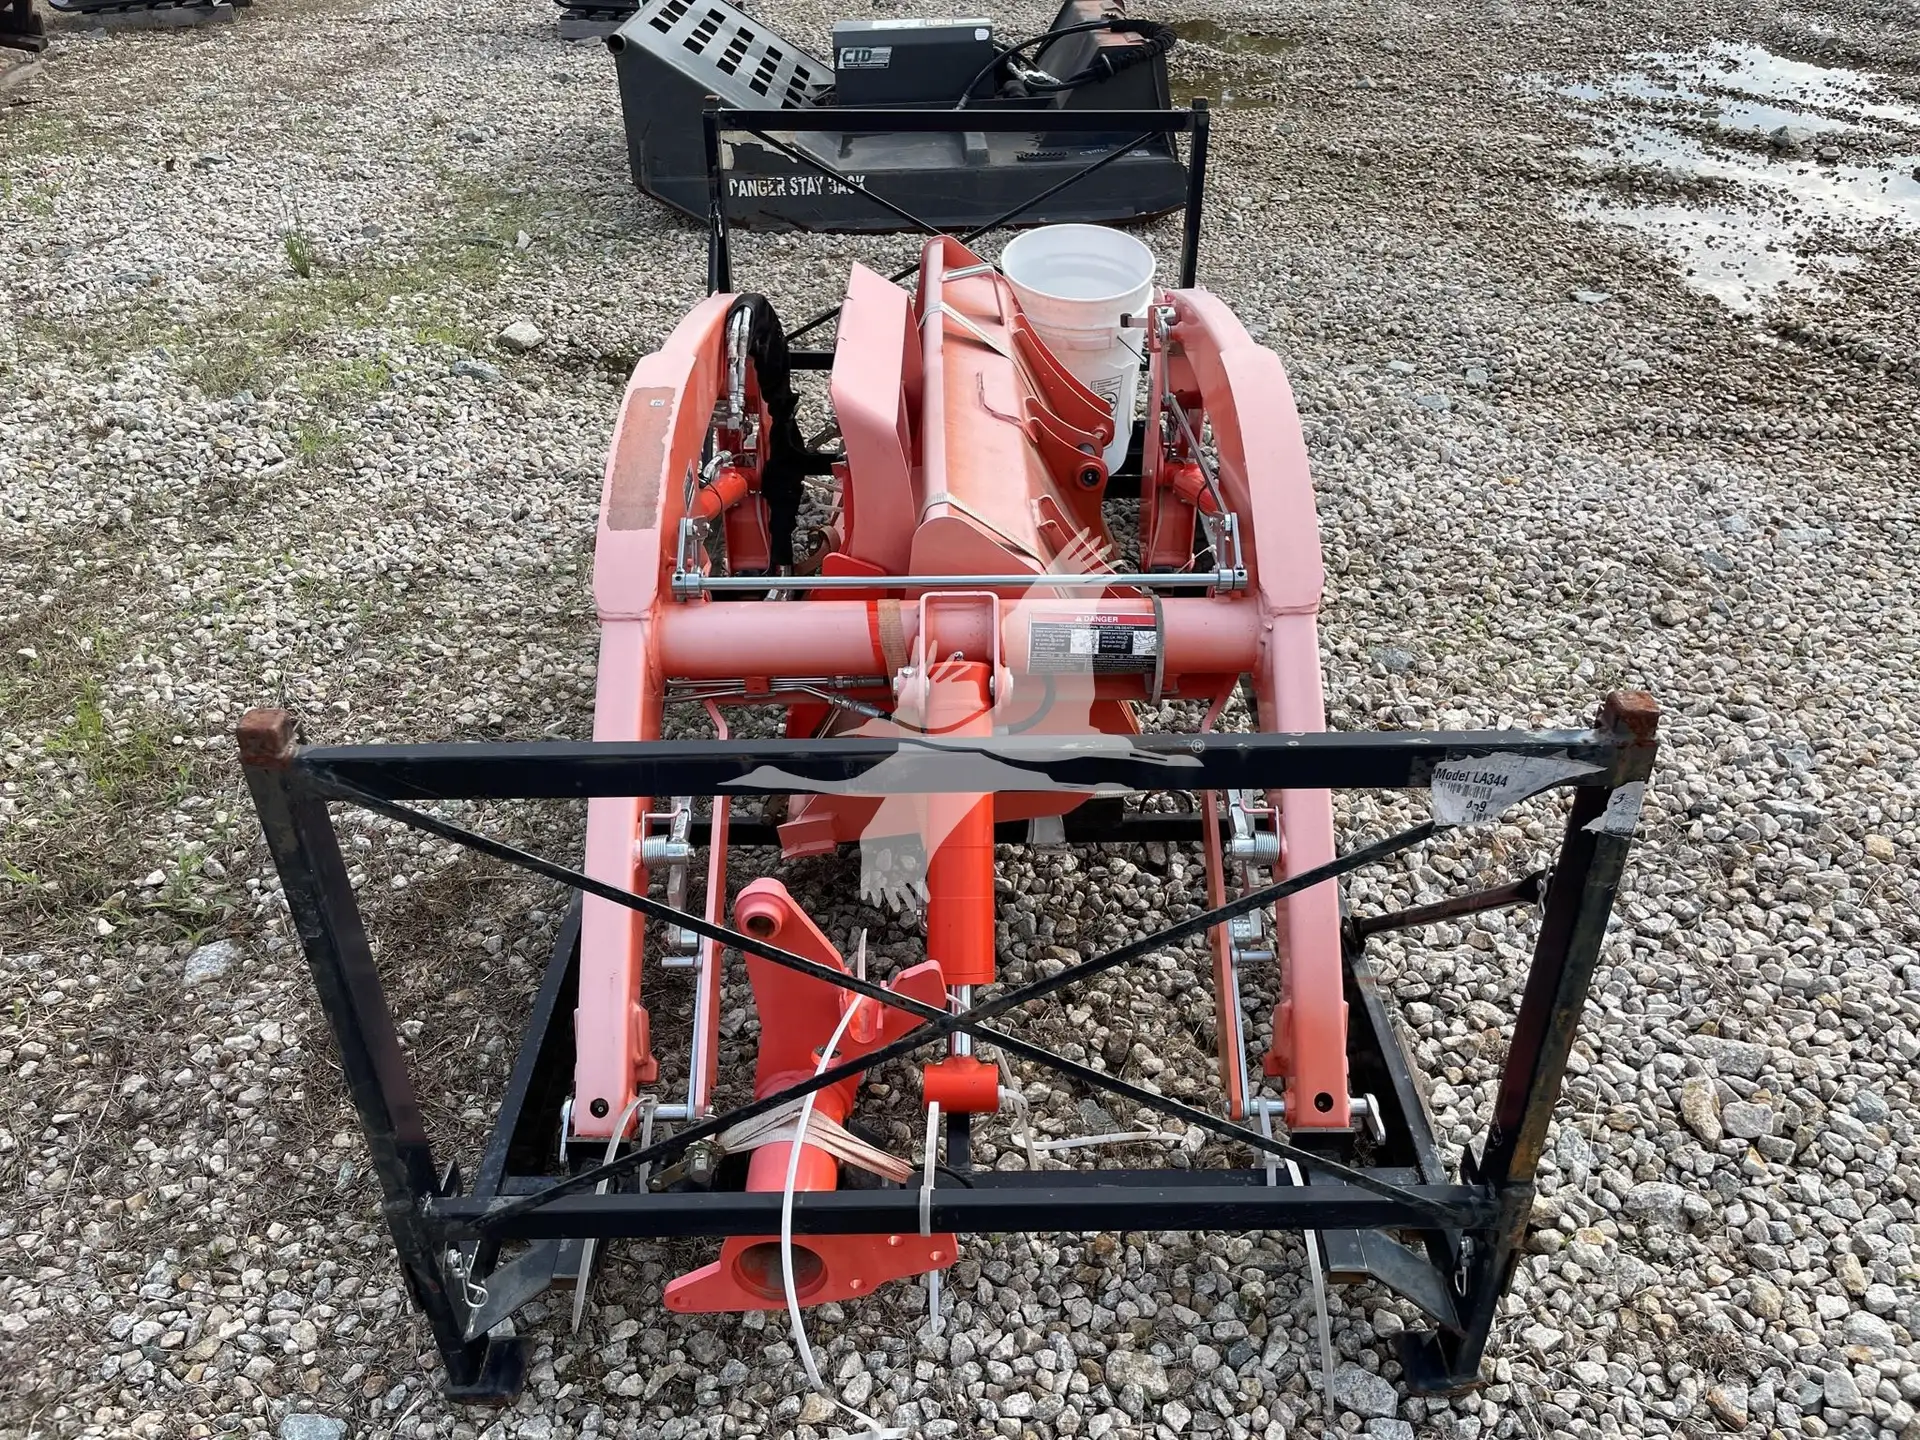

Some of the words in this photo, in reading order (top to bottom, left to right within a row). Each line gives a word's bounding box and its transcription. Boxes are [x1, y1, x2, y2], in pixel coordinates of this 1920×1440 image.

[843, 49, 872, 62] CID
[790, 176, 823, 196] STAY
[1084, 615, 1118, 623] DANGER
[1435, 768, 1470, 782] Model
[1472, 772, 1508, 787] LA344
